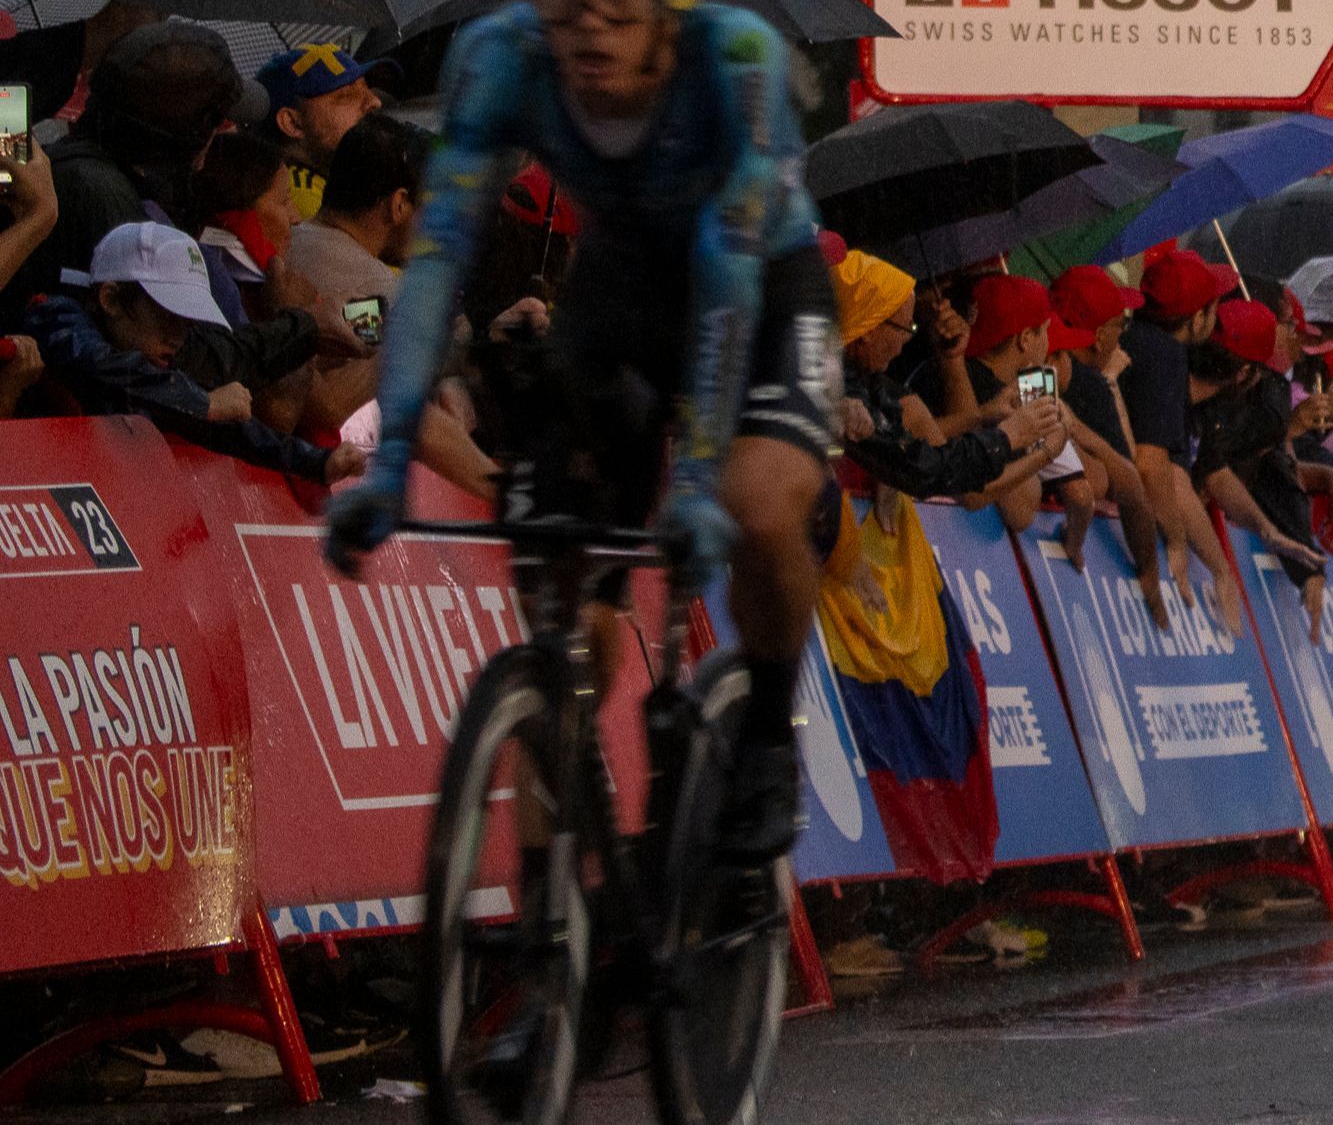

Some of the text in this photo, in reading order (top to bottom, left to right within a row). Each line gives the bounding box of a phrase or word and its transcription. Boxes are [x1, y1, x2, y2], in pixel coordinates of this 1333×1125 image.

[904, 21, 1313, 47] SWISS WATCHES SINCE 1853
[71, 500, 119, 555] 23
[0, 623, 198, 757] LA PASIÓN
[292, 583, 535, 749] LA VUET
[984, 704, 1035, 749] ORTE
[72, 748, 172, 873] NOS
[165, 744, 238, 865] UNE
